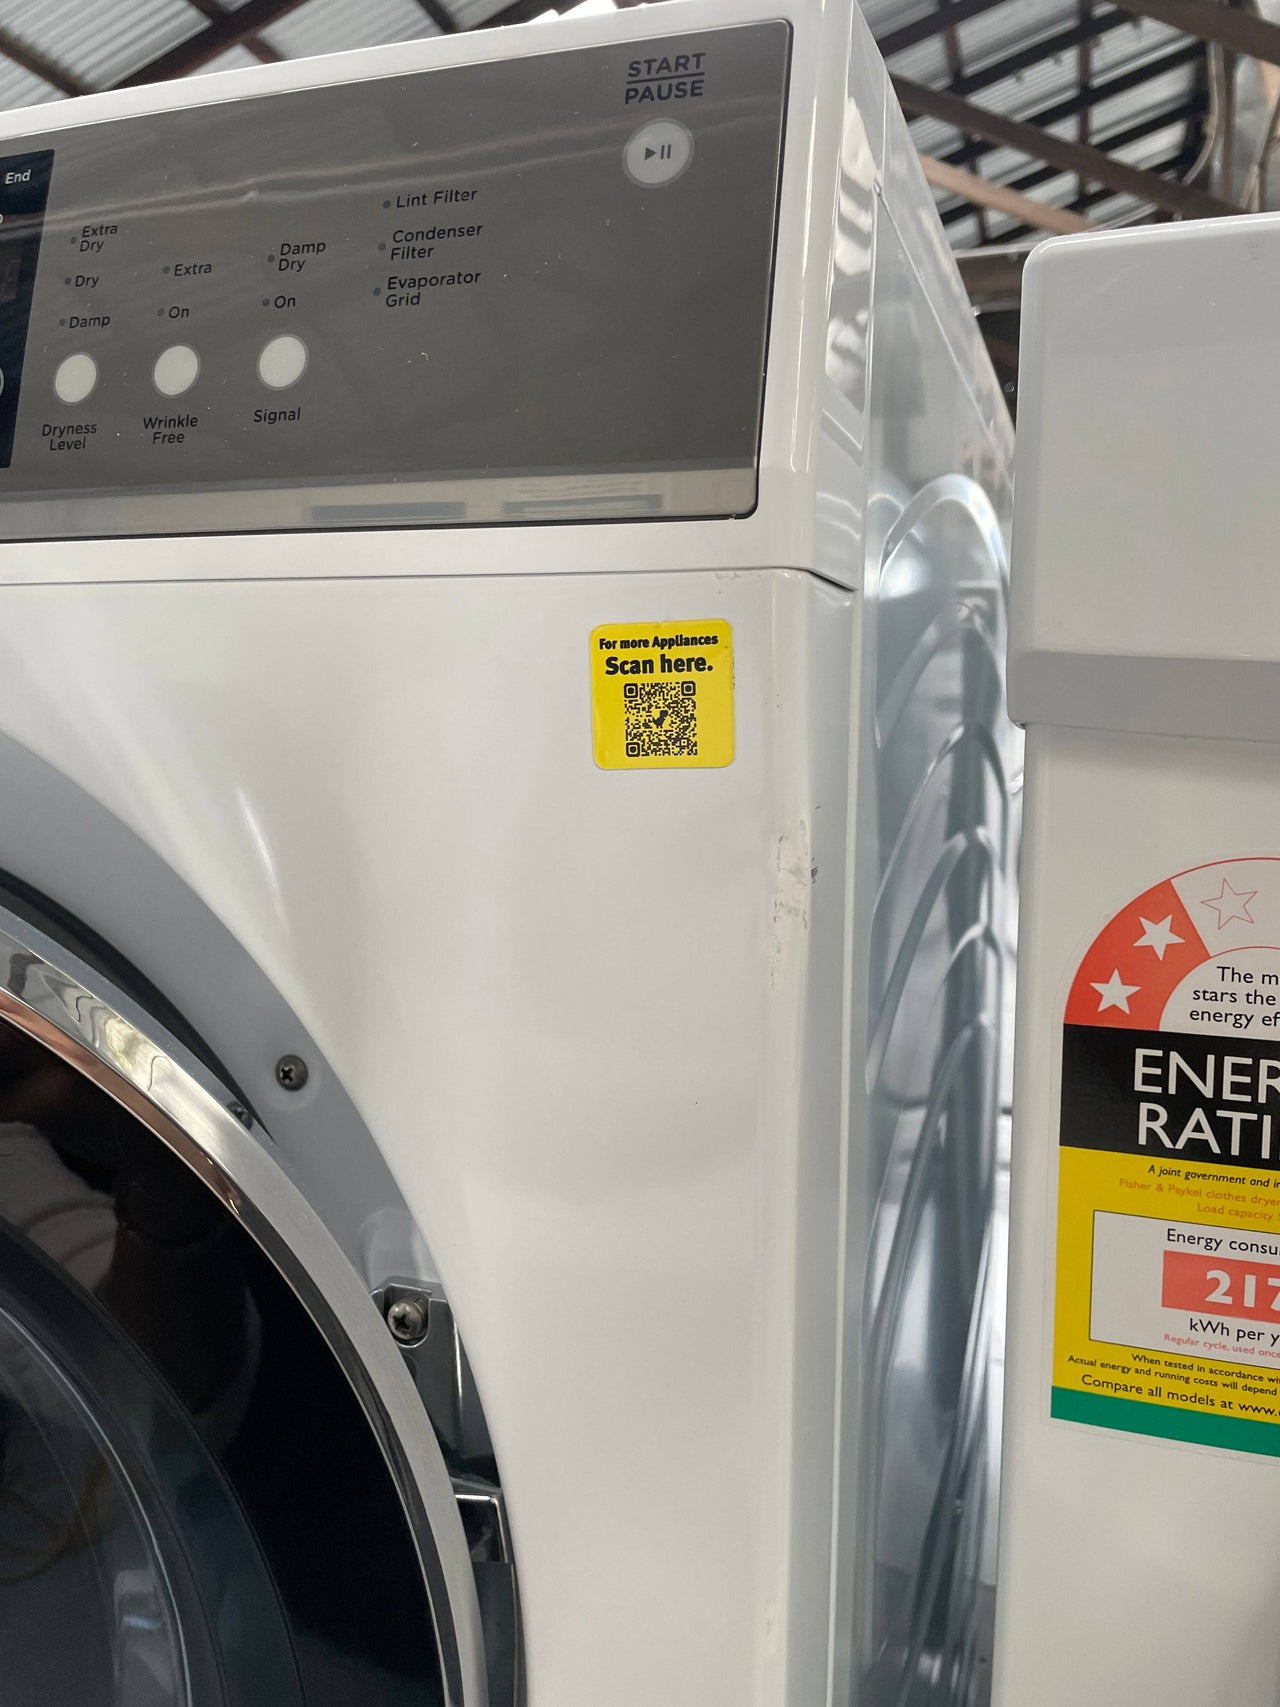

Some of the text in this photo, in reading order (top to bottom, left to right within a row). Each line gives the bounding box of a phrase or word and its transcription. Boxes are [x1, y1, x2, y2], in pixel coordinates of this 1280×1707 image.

[628, 52, 706, 77] START
[624, 80, 705, 104] PAUSE
[5, 169, 31, 184] End
[396, 189, 478, 208] Lint Filter
[82, 223, 118, 238] Extra
[392, 224, 483, 243] Condenser
[79, 240, 104, 253] Dry
[280, 241, 326, 256] Damp
[390, 245, 434, 261] Filter
[174, 263, 212, 277] Extra
[278, 258, 306, 273] Dry
[75, 275, 99, 288] Dry
[387, 271, 482, 291] Evaporator
[273, 295, 296, 309] On
[385, 292, 421, 308] Grid
[69, 314, 111, 329] Damp
[168, 306, 190, 320] On
[143, 414, 199, 431] Wrinkle
[253, 407, 302, 425] Signal
[42, 422, 98, 439] Dryness
[152, 431, 185, 445] Free
[49, 437, 86, 451] Level
[599, 634, 719, 650] For more Appliances
[605, 653, 714, 675] Scan here.
[1216, 965, 1254, 985] The
[1192, 988, 1276, 1006] stars the
[1189, 1009, 1255, 1030] energy
[1133, 1047, 1280, 1105] ENER
[1137, 1102, 1280, 1161] RATI
[1147, 1164, 1156, 1174] A
[1158, 1165, 1181, 1178] joint
[1184, 1169, 1246, 1187] government
[1250, 1177, 1270, 1188] and
[1119, 1177, 1152, 1191] Fisher
[1156, 1183, 1164, 1193] &
[1168, 1185, 1202, 1199] Paykel
[1206, 1189, 1246, 1203] clothes
[1197, 1202, 1225, 1215] Load
[1228, 1208, 1273, 1223] capacity
[1167, 1227, 1280, 1256] Energy consu
[1189, 1317, 1230, 1337] kWh
[1236, 1327, 1265, 1342] per
[1163, 1333, 1199, 1347] Regular
[1202, 1339, 1230, 1352] cycle,
[1232, 1345, 1255, 1356] used
[1067, 1354, 1278, 1397] Actual energy and running costs will depend
[1131, 1353, 1160, 1366] When
[1164, 1359, 1194, 1371] tested
[1197, 1363, 1205, 1373] in
[1208, 1366, 1264, 1383] accordance
[1081, 1373, 1143, 1394] Compare
[1147, 1386, 1162, 1398] all
[1167, 1390, 1216, 1407] models
[1220, 1400, 1234, 1410] at
